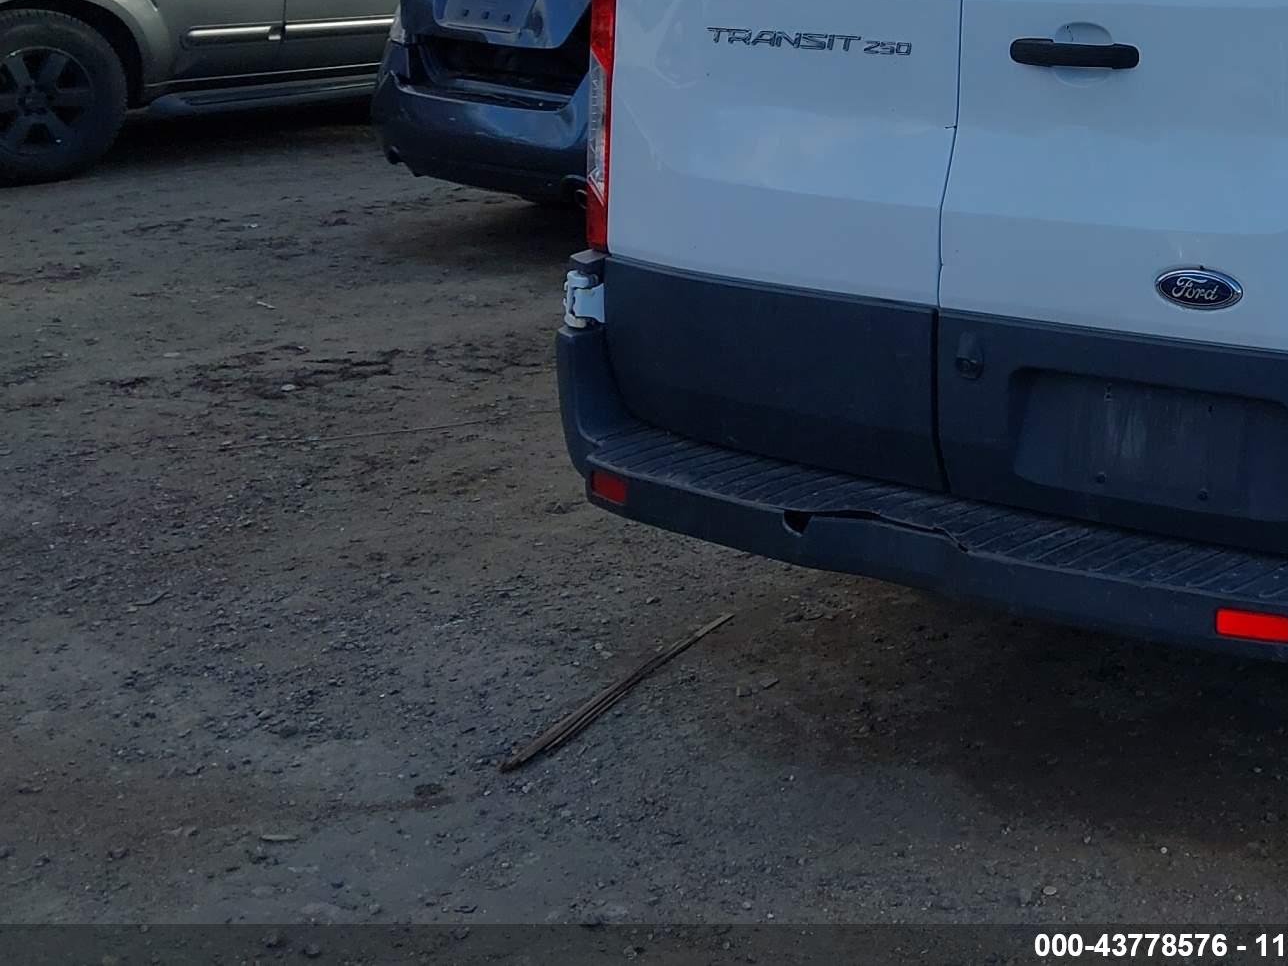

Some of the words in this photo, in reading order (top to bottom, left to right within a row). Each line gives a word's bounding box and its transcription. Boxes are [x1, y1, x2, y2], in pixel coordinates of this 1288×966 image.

[706, 26, 861, 51] TRANSIT
[863, 41, 912, 55] 250
[1171, 276, 1219, 301] Ford
